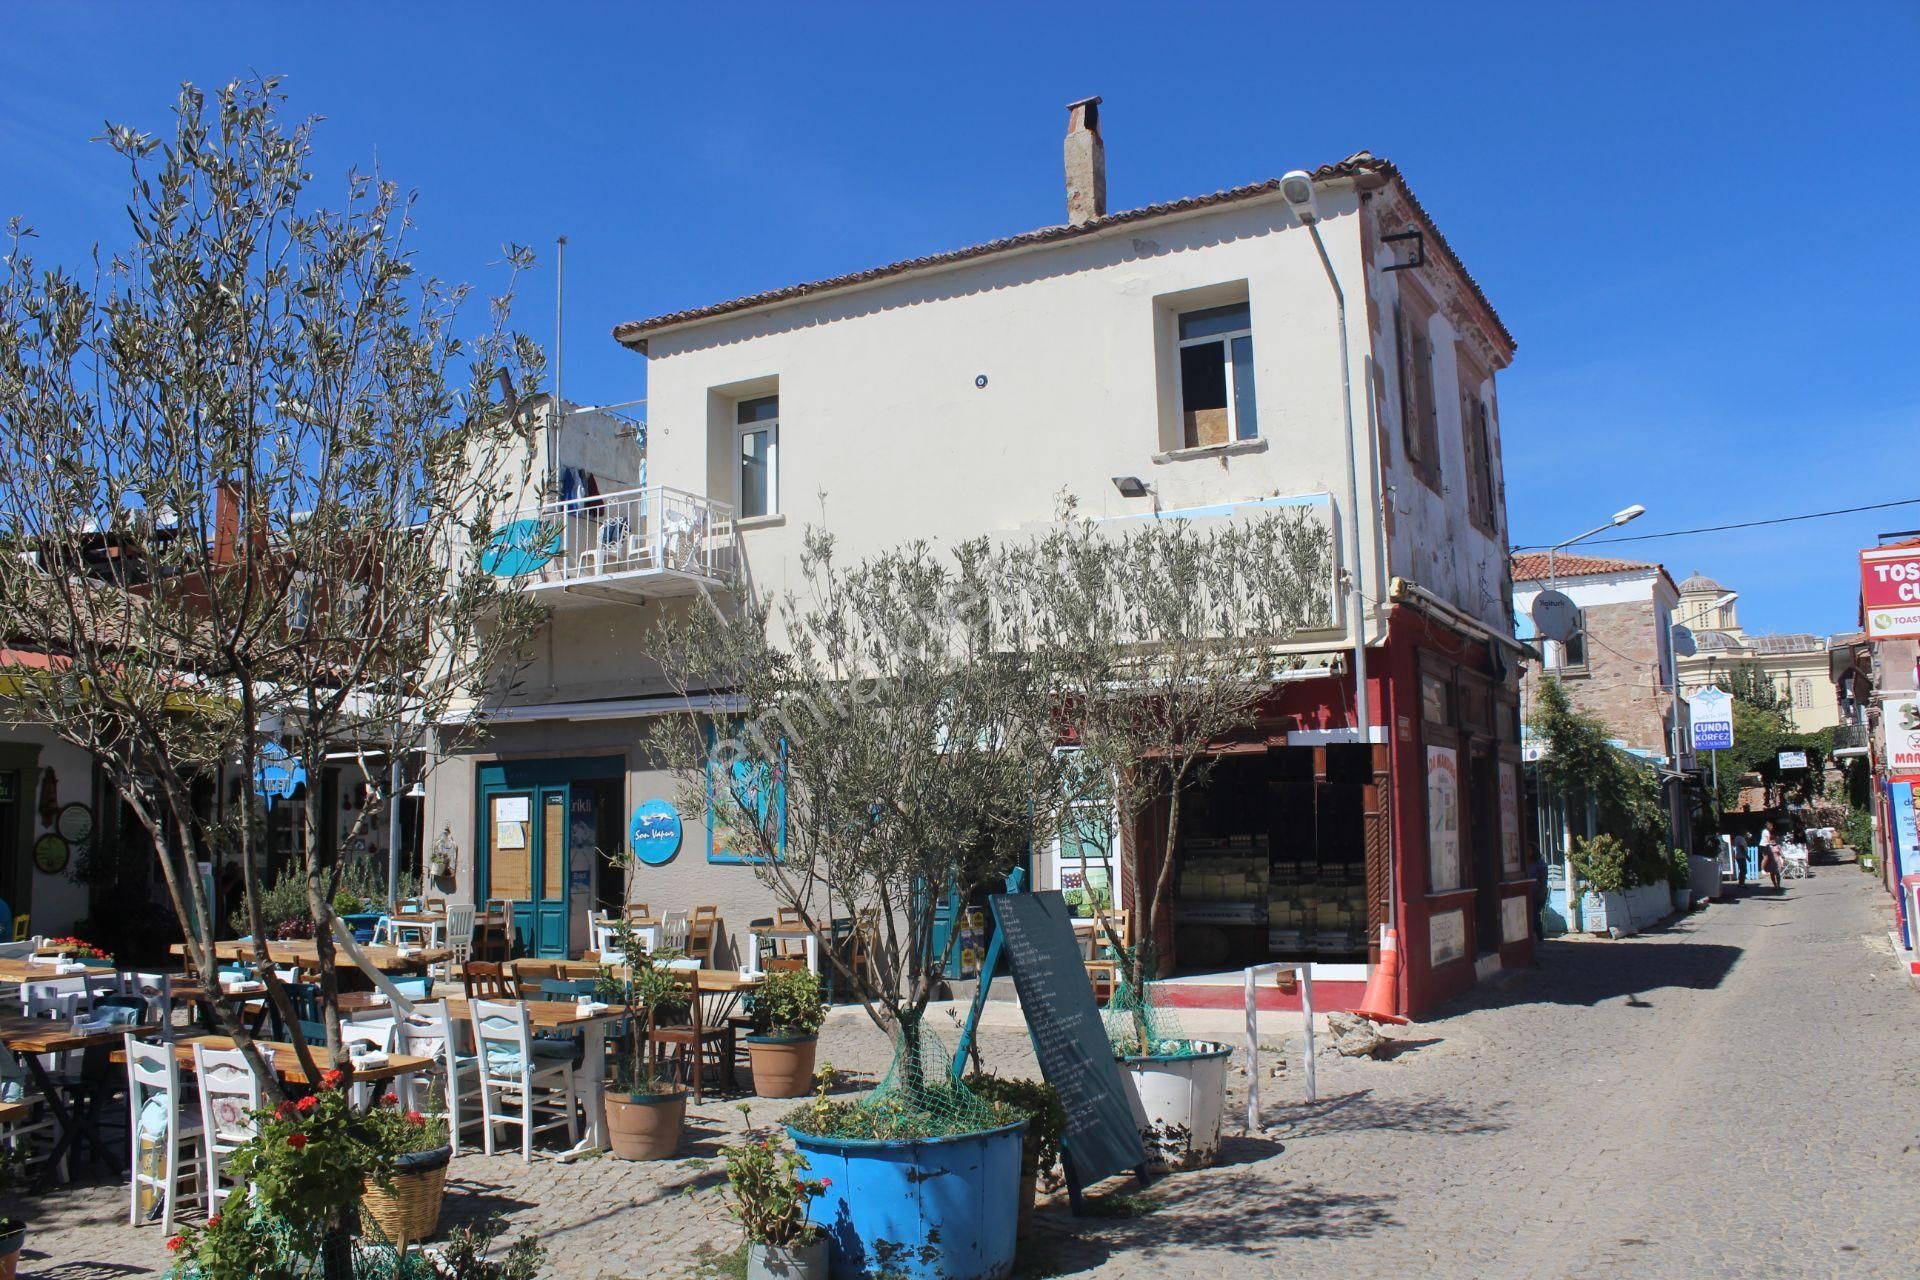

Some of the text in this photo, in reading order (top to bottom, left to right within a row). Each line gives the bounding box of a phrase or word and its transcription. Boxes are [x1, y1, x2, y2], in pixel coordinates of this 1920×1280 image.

[1874, 562, 1920, 582] TOS
[1695, 722, 1729, 733] CUNDA
[1695, 731, 1729, 742] KÖRFEZ
[635, 829, 675, 841] Son Vapur
